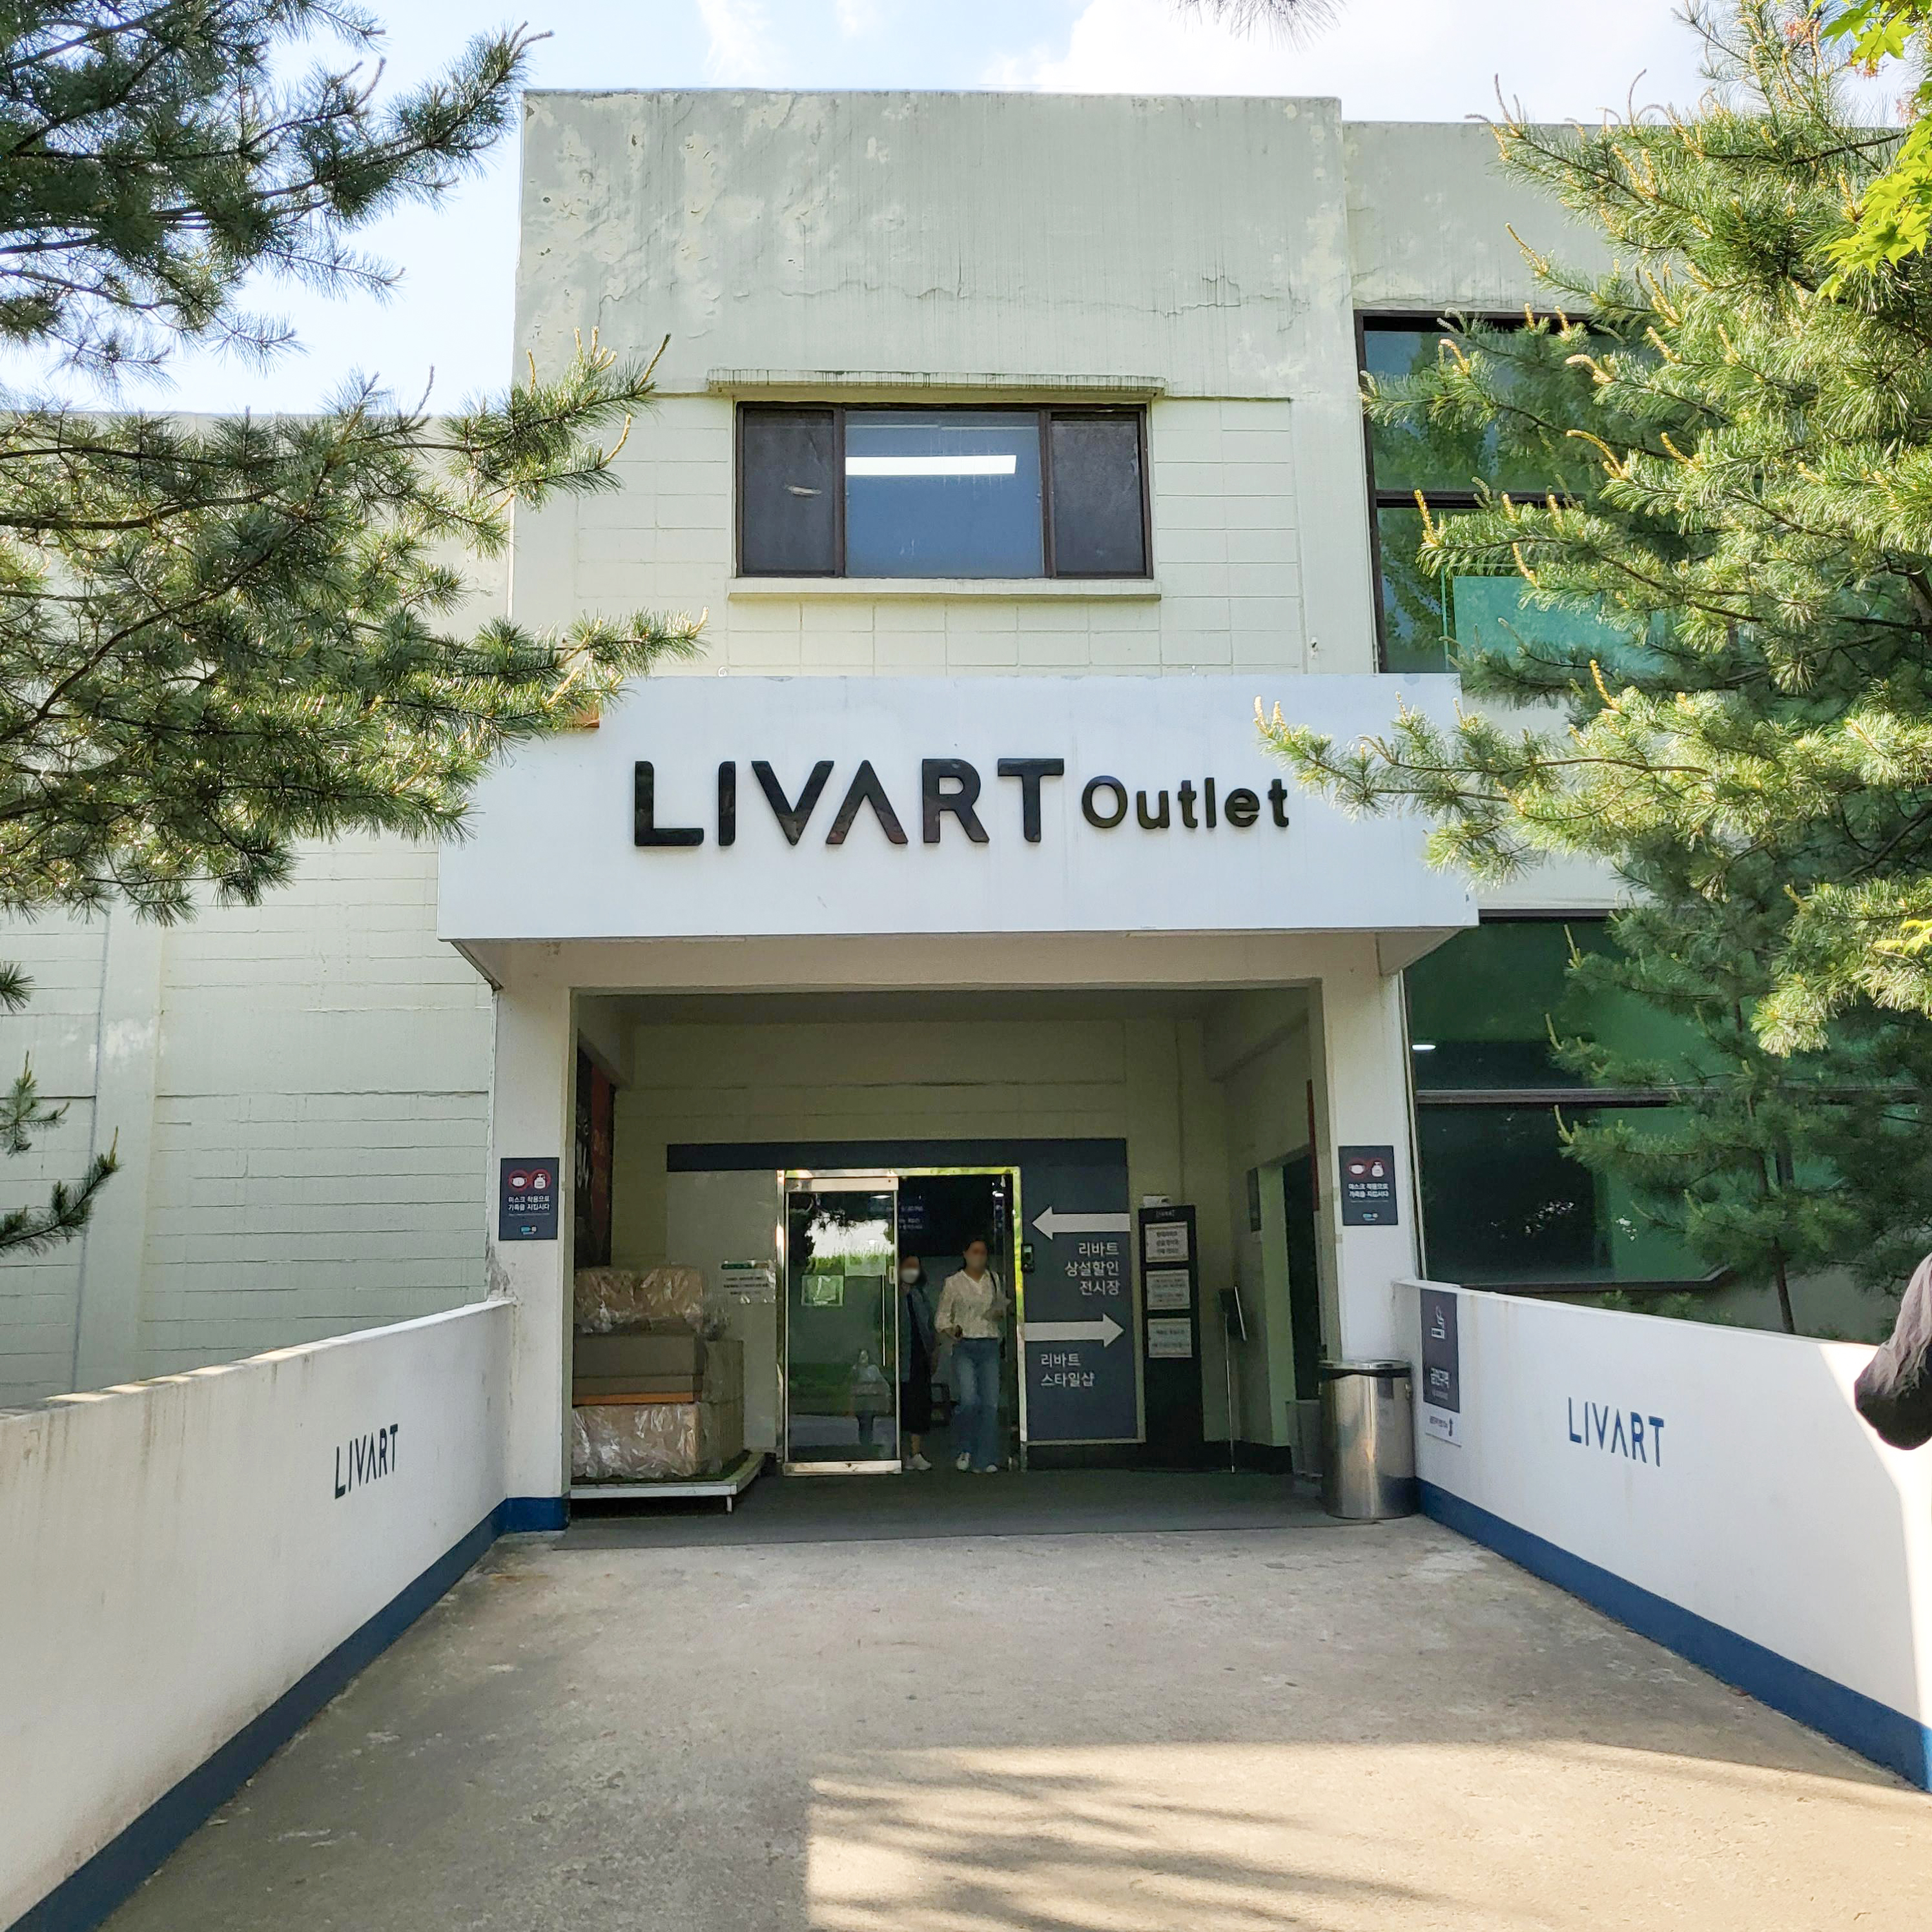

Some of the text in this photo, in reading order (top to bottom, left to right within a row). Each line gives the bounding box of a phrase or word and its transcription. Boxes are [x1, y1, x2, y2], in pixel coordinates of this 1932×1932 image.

[634, 757, 1290, 847] LIVART Outlet
[1078, 1242, 1120, 1257] 리바트
[1064, 1261, 1120, 1278] 상설할인
[1079, 1280, 1121, 1296] 전시장
[1040, 1353, 1081, 1368] 리바트
[1040, 1372, 1094, 1388] 스타일샵
[1568, 1397, 1665, 1468] LIVART
[334, 1423, 398, 1499] LIVART
